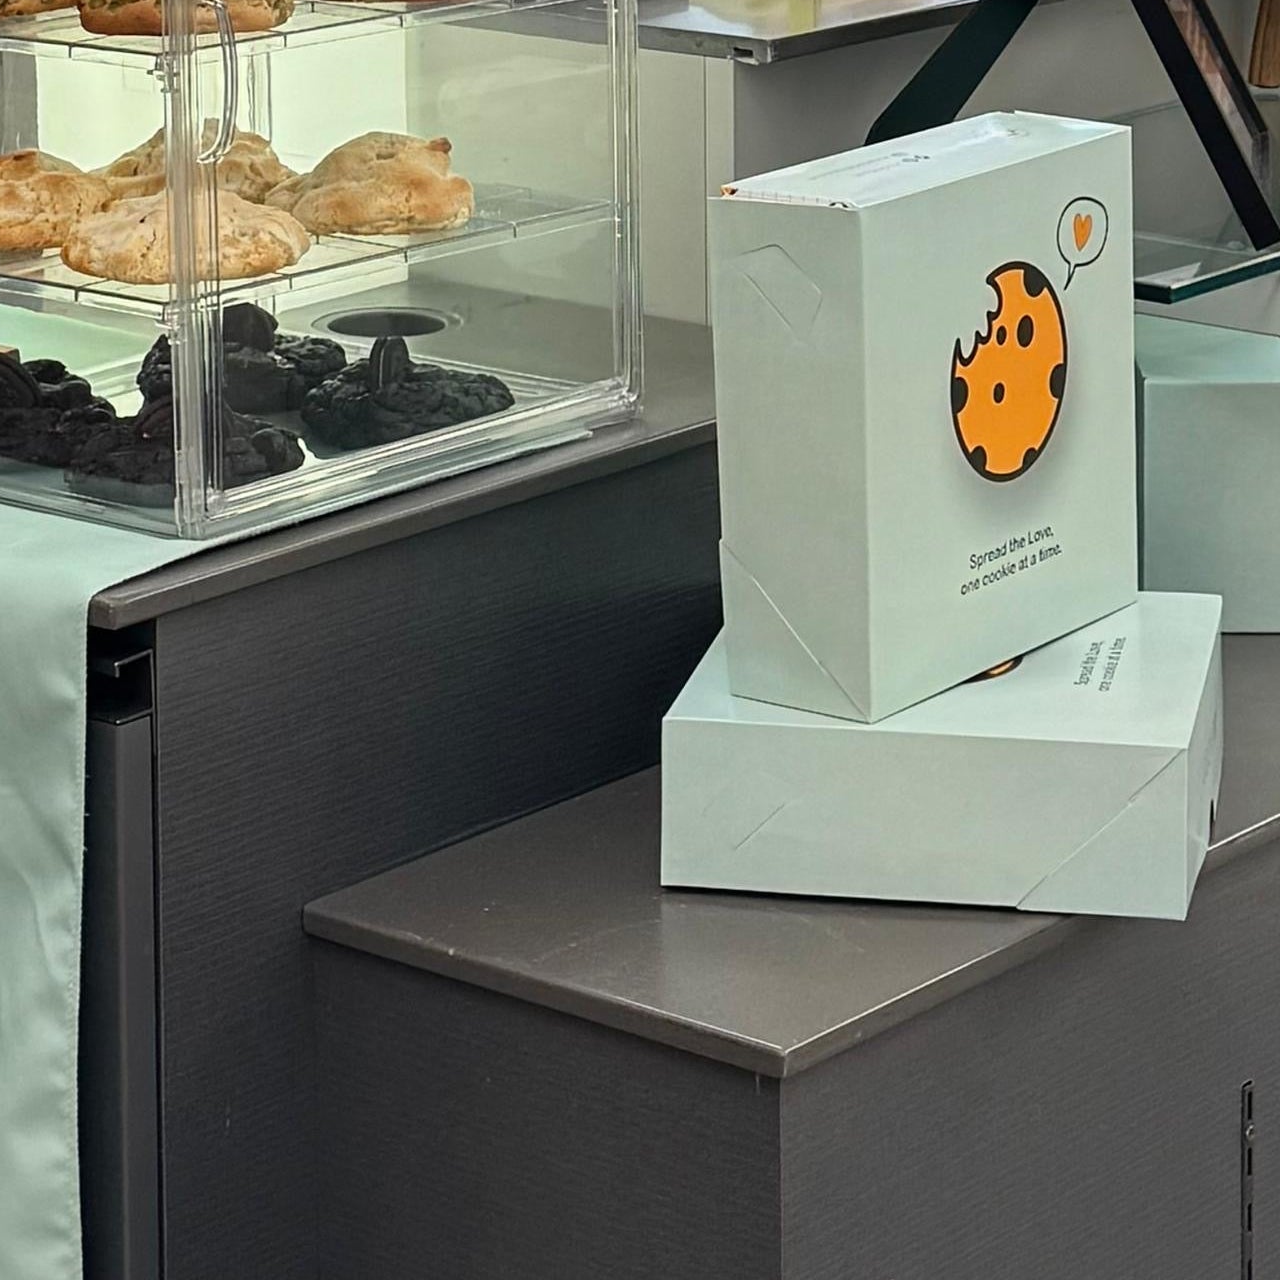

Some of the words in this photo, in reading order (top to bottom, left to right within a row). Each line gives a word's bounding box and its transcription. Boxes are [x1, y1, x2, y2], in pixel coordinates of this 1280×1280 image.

[970, 541, 1007, 570] Spread
[1008, 536, 1026, 552] the
[960, 578, 980, 595] one
[982, 561, 1017, 586] cookie
[1018, 555, 1029, 571] at
[1030, 553, 1038, 566] a
